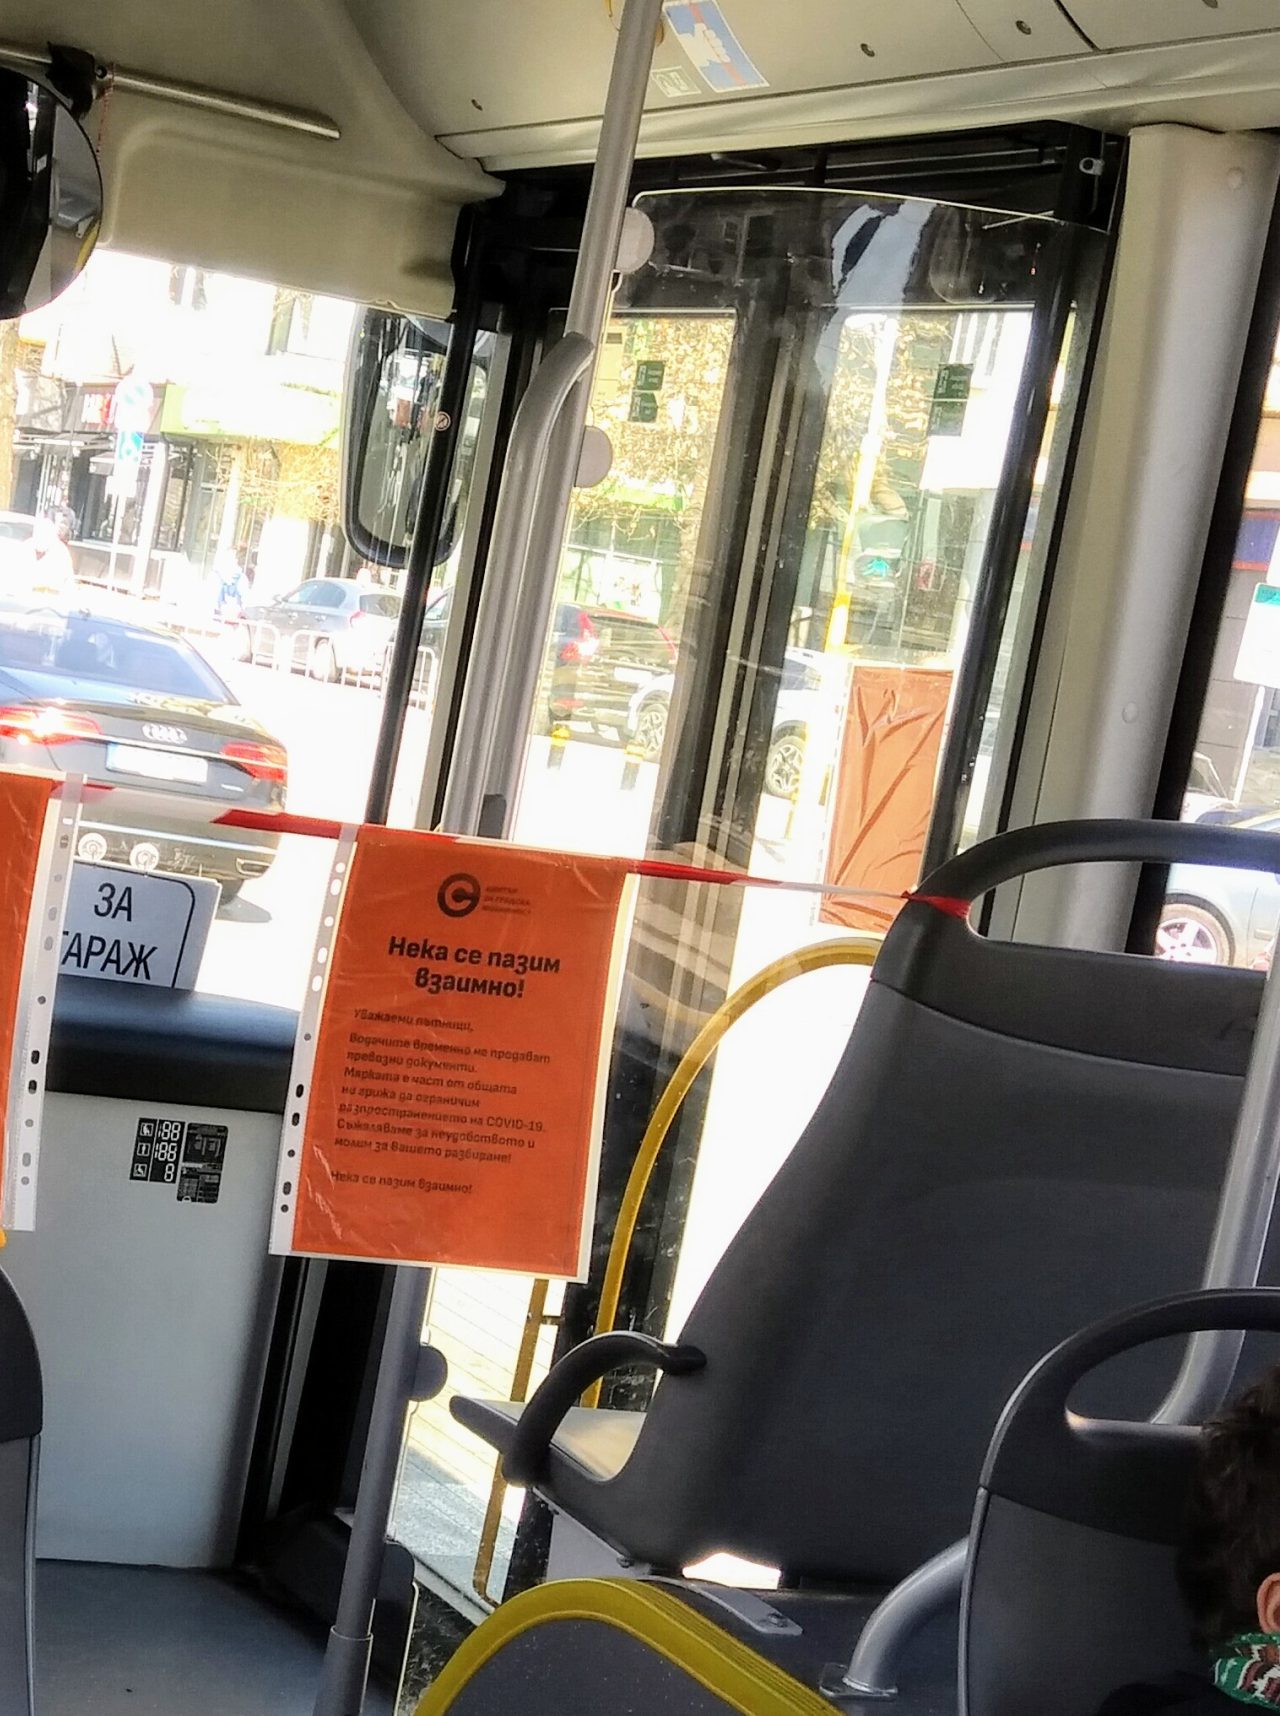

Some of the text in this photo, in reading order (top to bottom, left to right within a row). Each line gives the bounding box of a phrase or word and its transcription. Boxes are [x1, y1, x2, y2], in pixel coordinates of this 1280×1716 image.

[94, 882, 133, 922] ЗА
[388, 936, 560, 975] Нека се пазим
[415, 967, 524, 998] взаимно!
[354, 1009, 474, 1032] Уважаеми пътници,
[347, 1051, 403, 1066] превозни
[349, 1032, 550, 1064] Водачите временно не продават
[344, 1067, 517, 1094] Мярката е част от общата
[340, 1085, 480, 1107] ни грижа да ограничим
[469, 1116, 484, 1127] на
[414, 1127, 429, 1140] за
[431, 1130, 525, 1148] неудобството
[527, 1139, 536, 1149] и
[334, 1138, 511, 1163] молим за Вашето разбиране!
[331, 1170, 473, 1194] Нека се пазим взаимно!
